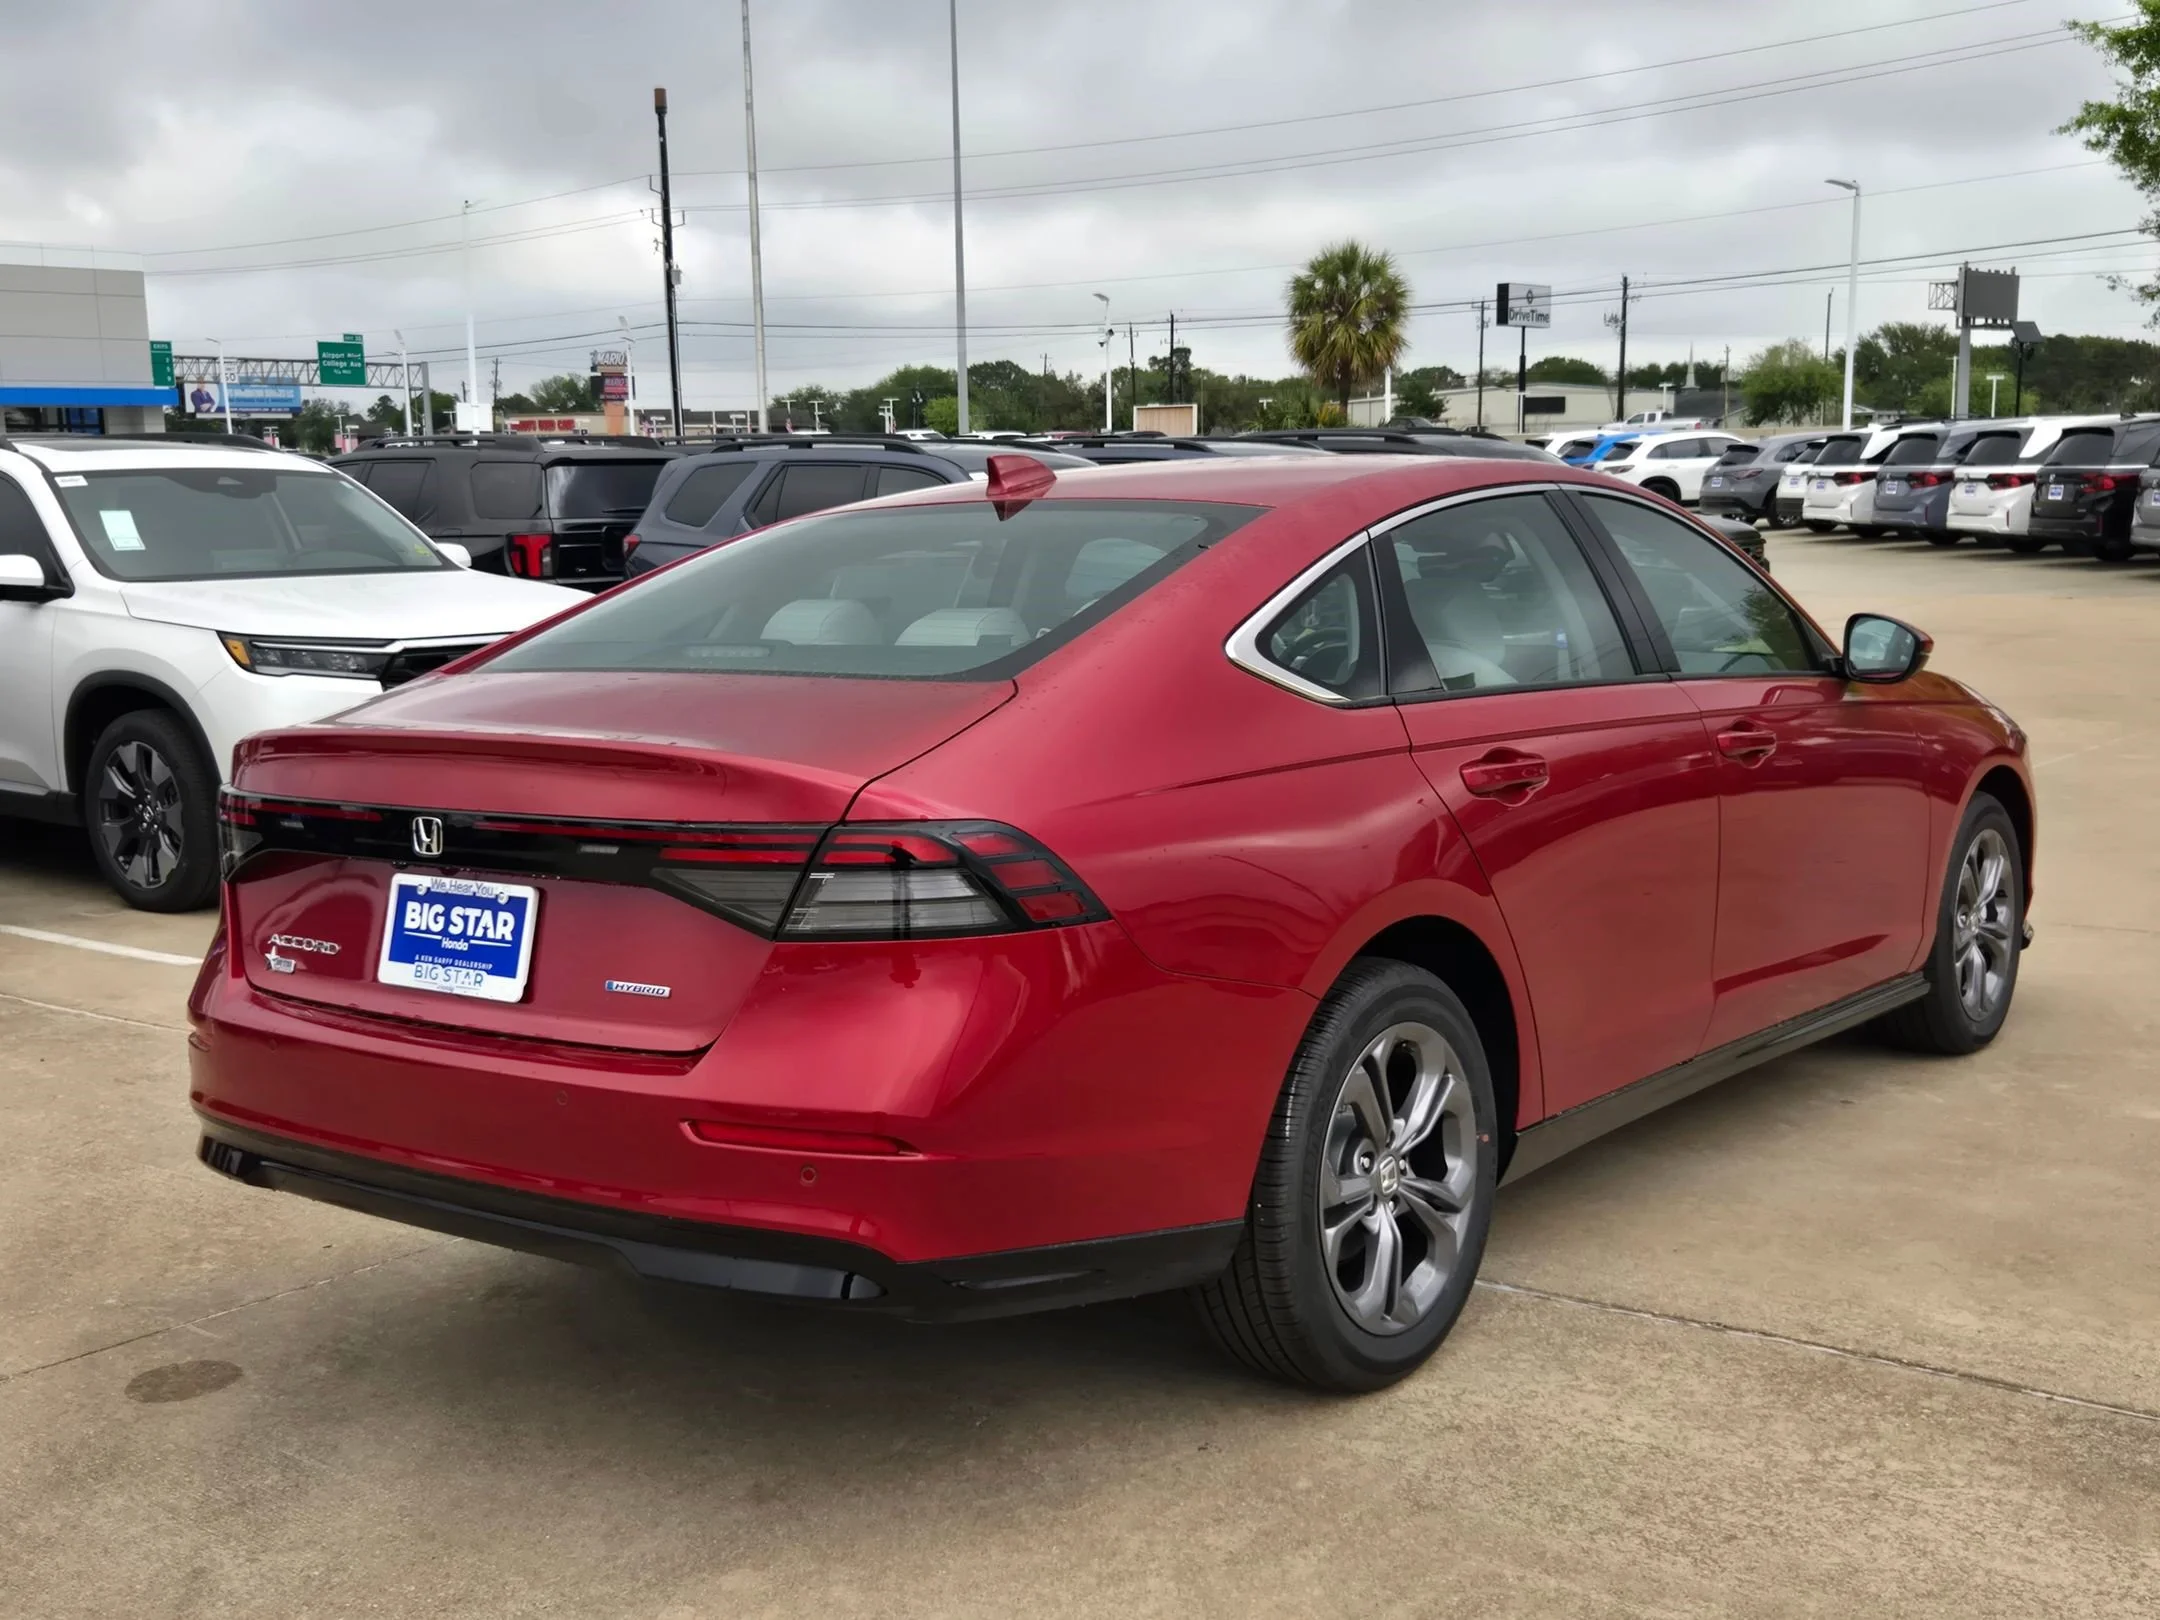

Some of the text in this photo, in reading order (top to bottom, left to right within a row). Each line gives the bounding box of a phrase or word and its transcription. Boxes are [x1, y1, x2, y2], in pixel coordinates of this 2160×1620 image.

[1509, 307, 1550, 323] DriveTime
[322, 352, 345, 360] Airport
[322, 360, 347, 368] College
[431, 878, 494, 897] We Hear You
[403, 900, 516, 941] BIG STAR
[267, 933, 342, 955] ACCORD
[441, 937, 469, 951] Honda
[420, 954, 433, 963] KEN
[433, 956, 453, 966] GARFF
[454, 959, 493, 971] DEALERSHIP
[414, 964, 439, 981] BIG
[442, 968, 484, 988] STAR
[615, 983, 666, 996] HYBRID
